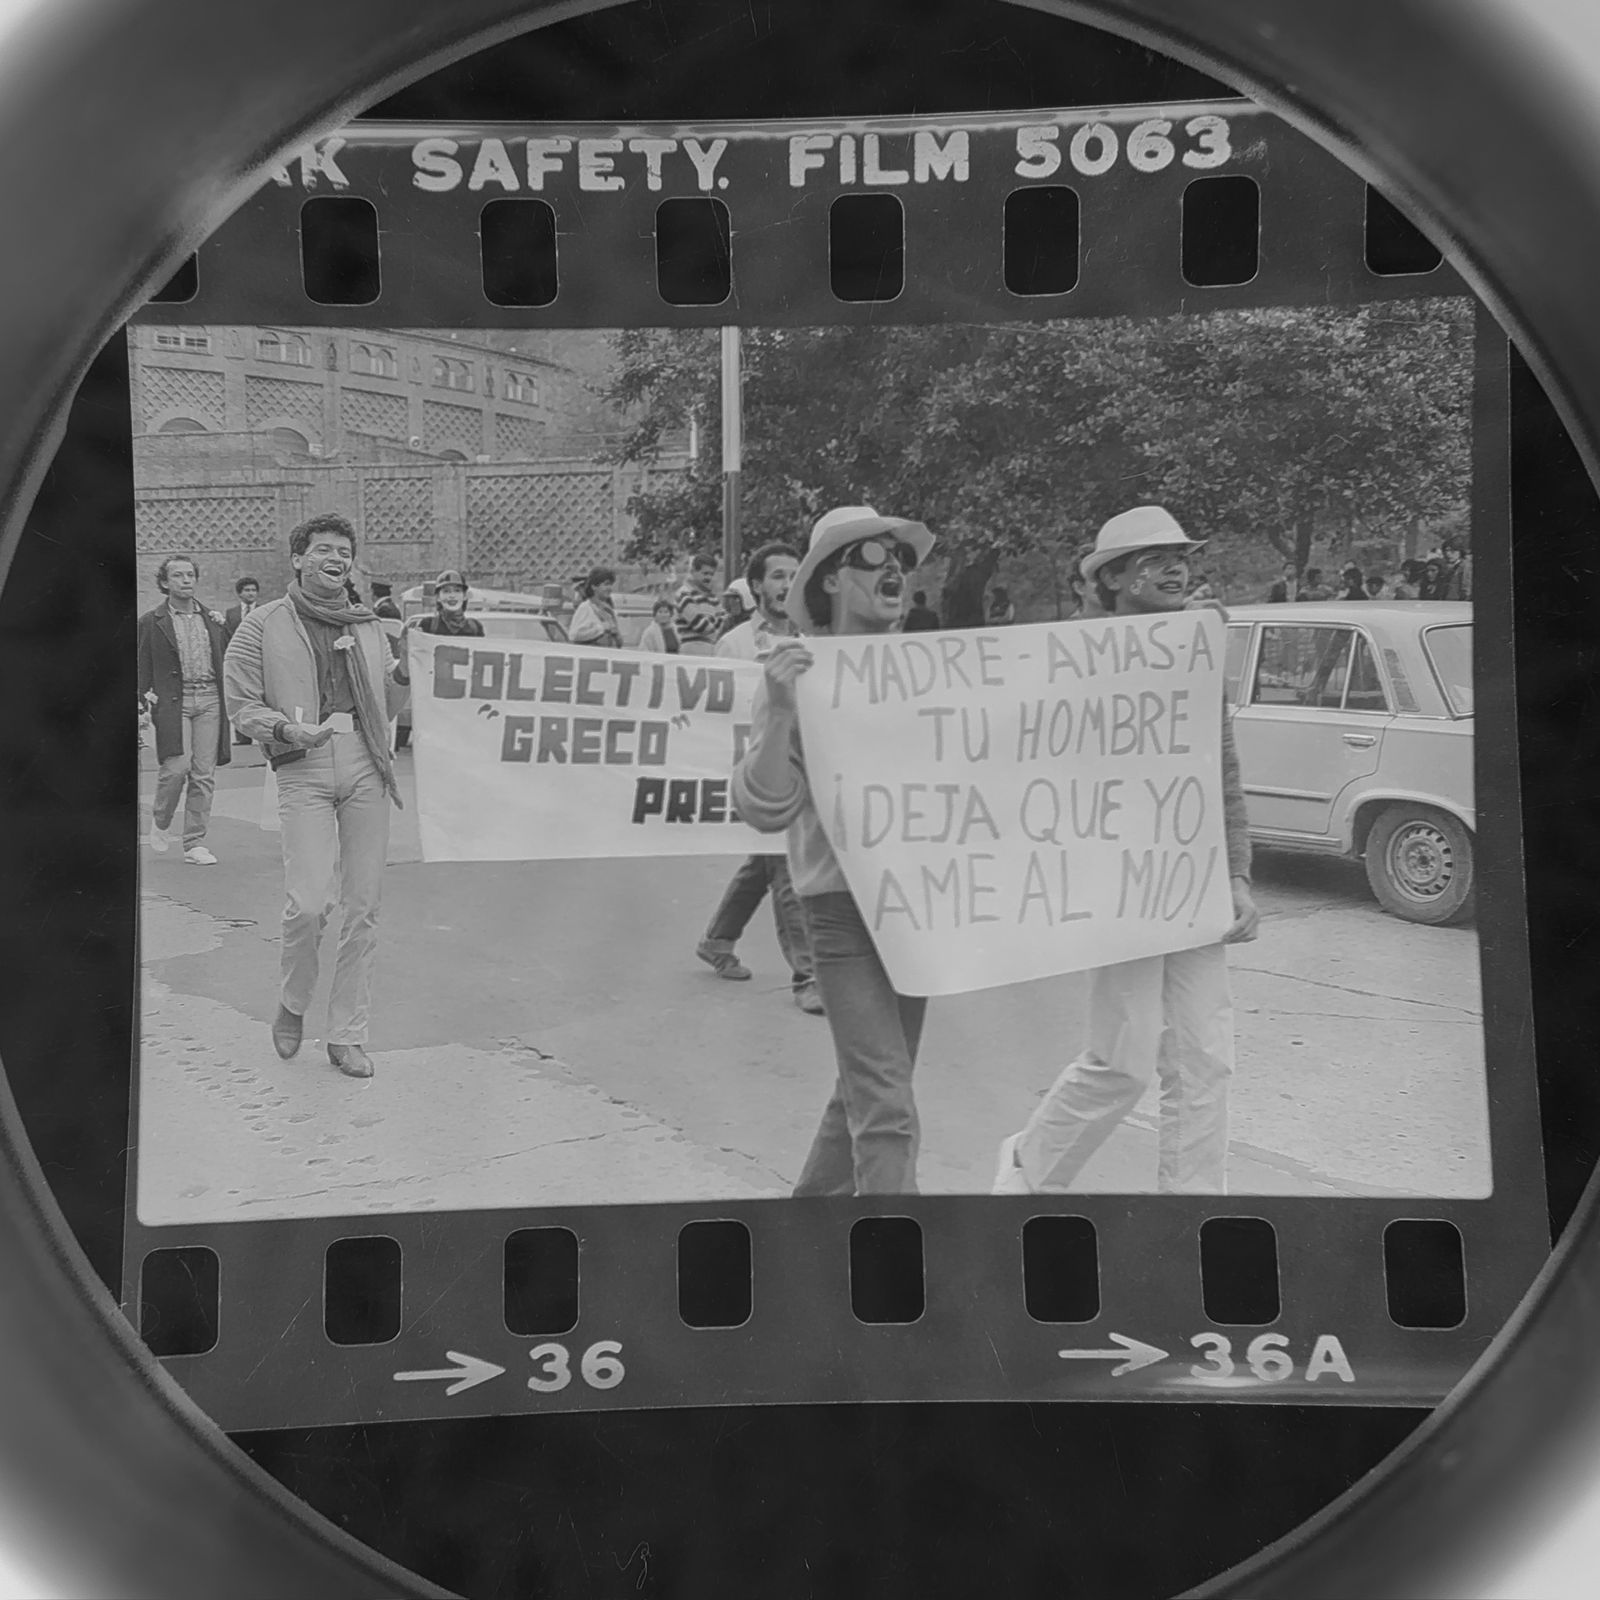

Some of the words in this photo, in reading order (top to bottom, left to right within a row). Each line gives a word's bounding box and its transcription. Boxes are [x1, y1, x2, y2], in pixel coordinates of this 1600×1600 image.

[411, 138, 730, 192] SAFETY.
[789, 130, 970, 188] FILM
[1014, 115, 1232, 179] 5063
[433, 645, 735, 714] COLECTIVO
[830, 636, 1005, 709] MADRE
[917, 706, 990, 763] TU
[1016, 690, 1190, 763] HOMBRE
[631, 775, 742, 825] PRE
[1020, 777, 1124, 846] QUE
[1143, 775, 1205, 846] YO
[874, 853, 998, 931] AME
[1017, 849, 1093, 926] AL
[1115, 845, 1219, 928] MIO!
[527, 1340, 626, 1392] 36
[1190, 1332, 1355, 1382] 36A
